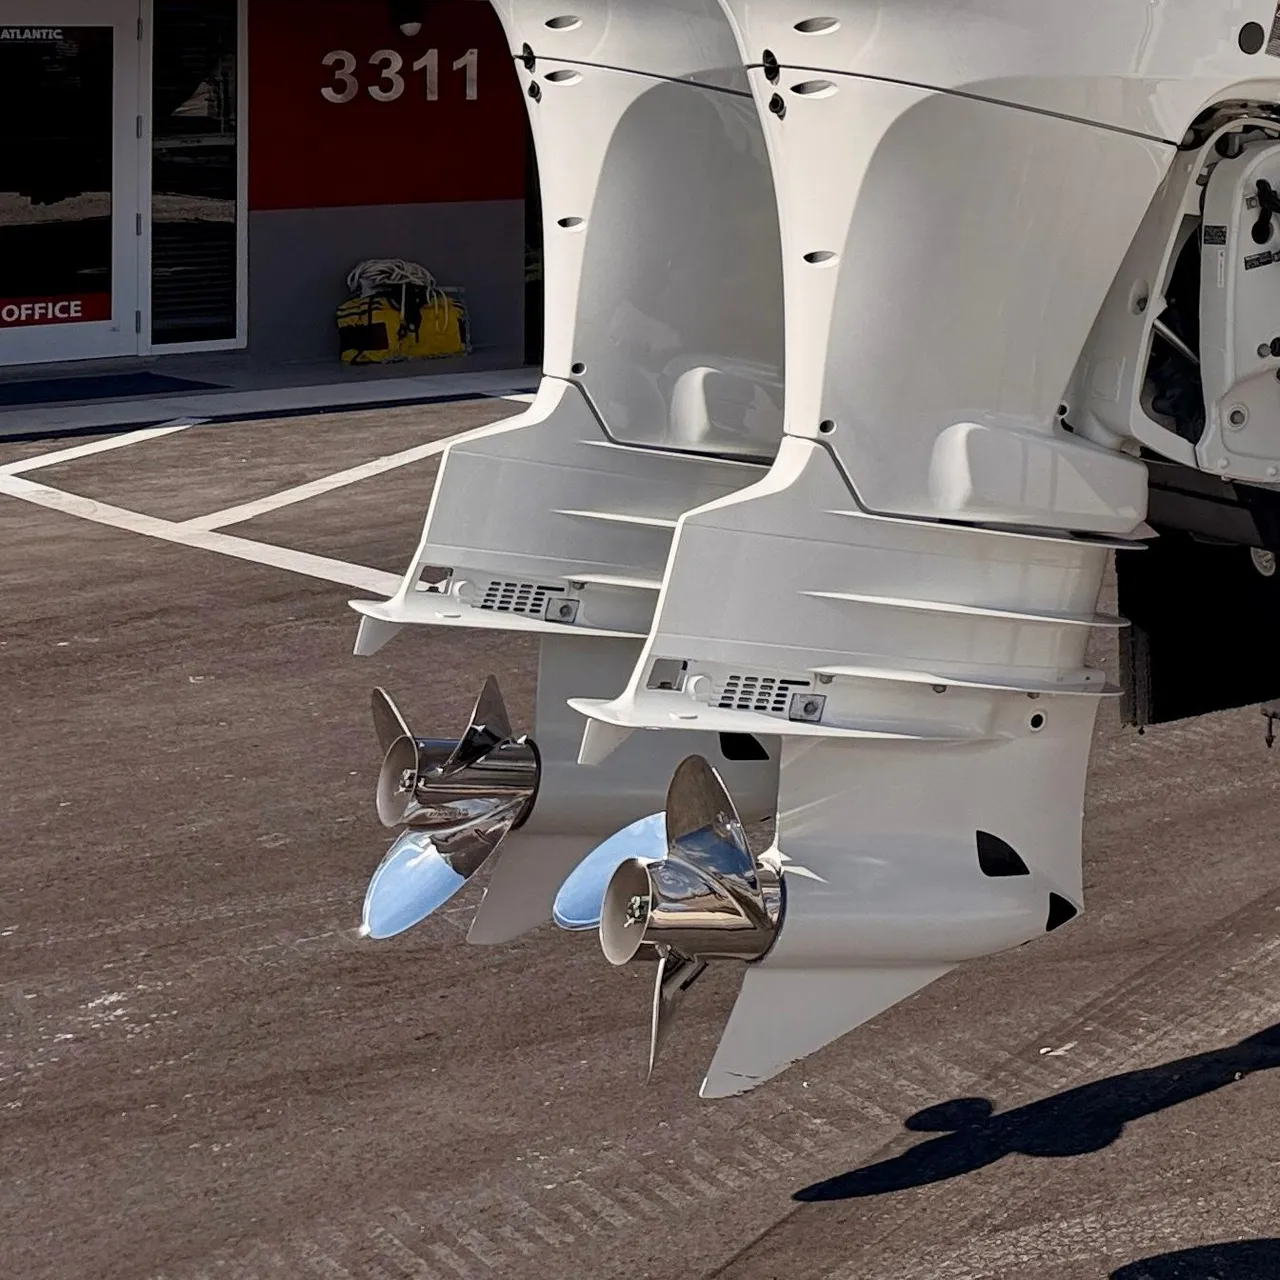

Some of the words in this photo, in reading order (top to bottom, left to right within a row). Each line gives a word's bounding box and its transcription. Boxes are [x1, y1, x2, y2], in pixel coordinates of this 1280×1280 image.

[0, 29, 63, 40] ATLANTIC
[320, 48, 479, 104] 3311
[1, 300, 82, 322] OFFICE
